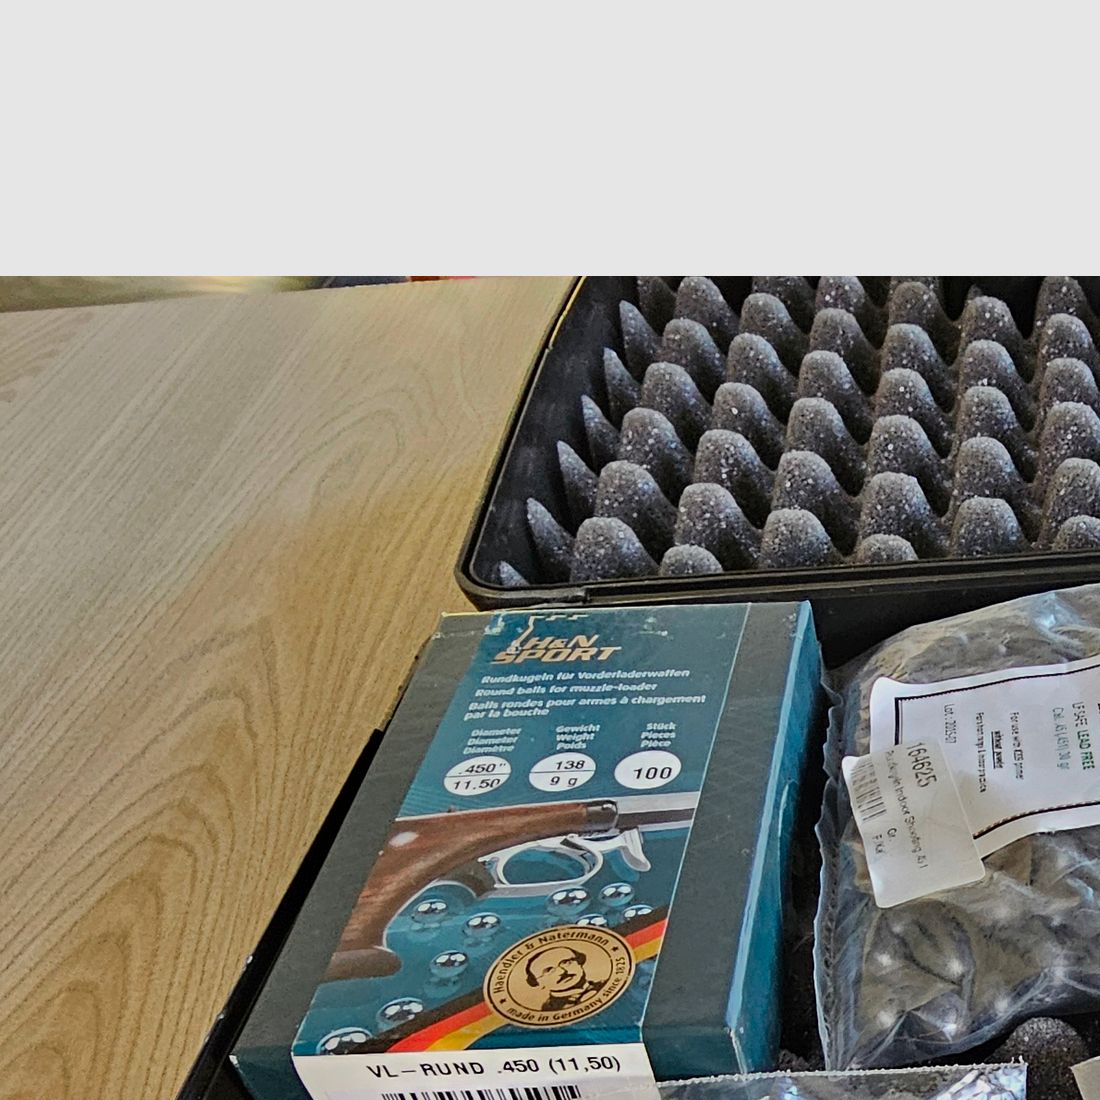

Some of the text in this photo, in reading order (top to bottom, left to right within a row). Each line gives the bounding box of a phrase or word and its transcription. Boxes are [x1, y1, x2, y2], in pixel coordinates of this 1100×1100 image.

[524, 635, 600, 648] H&N
[491, 647, 622, 663] SPORT
[482, 668, 690, 684] Rundkugeln für Vorderladerwaffen
[475, 682, 657, 697] Round balls for muzzle-loader
[469, 701, 498, 711] Balls
[502, 700, 544, 710] rondes
[546, 699, 576, 709] pour
[579, 697, 617, 706] armes
[631, 694, 706, 705] chargement
[464, 707, 550, 721] par la bouche
[471, 727, 521, 737] Diameter
[555, 724, 600, 734] Gewicht
[646, 722, 676, 730] Stück
[467, 736, 518, 746] Diameter
[555, 732, 595, 742] Weight
[640, 731, 676, 740] Pieces
[1077, 729, 1091, 750] LEAD
[556, 741, 587, 750] Poids
[640, 739, 671, 748] Pièce
[555, 759, 585, 770] 138
[905, 741, 938, 788] 164625
[1080, 751, 1094, 770] FREE
[633, 767, 672, 780] 100
[453, 777, 501, 790] 11.50
[550, 775, 578, 788] 9 g
[893, 787, 910, 815] Indoor
[493, 931, 609, 994] Haendler & Natermann
[507, 1007, 534, 1021] made
[552, 999, 602, 1020] Germany
[602, 978, 620, 998] since
[614, 956, 626, 974] 1825
[497, 1059, 539, 1074] .450
[549, 1056, 622, 1075] (11,50)
